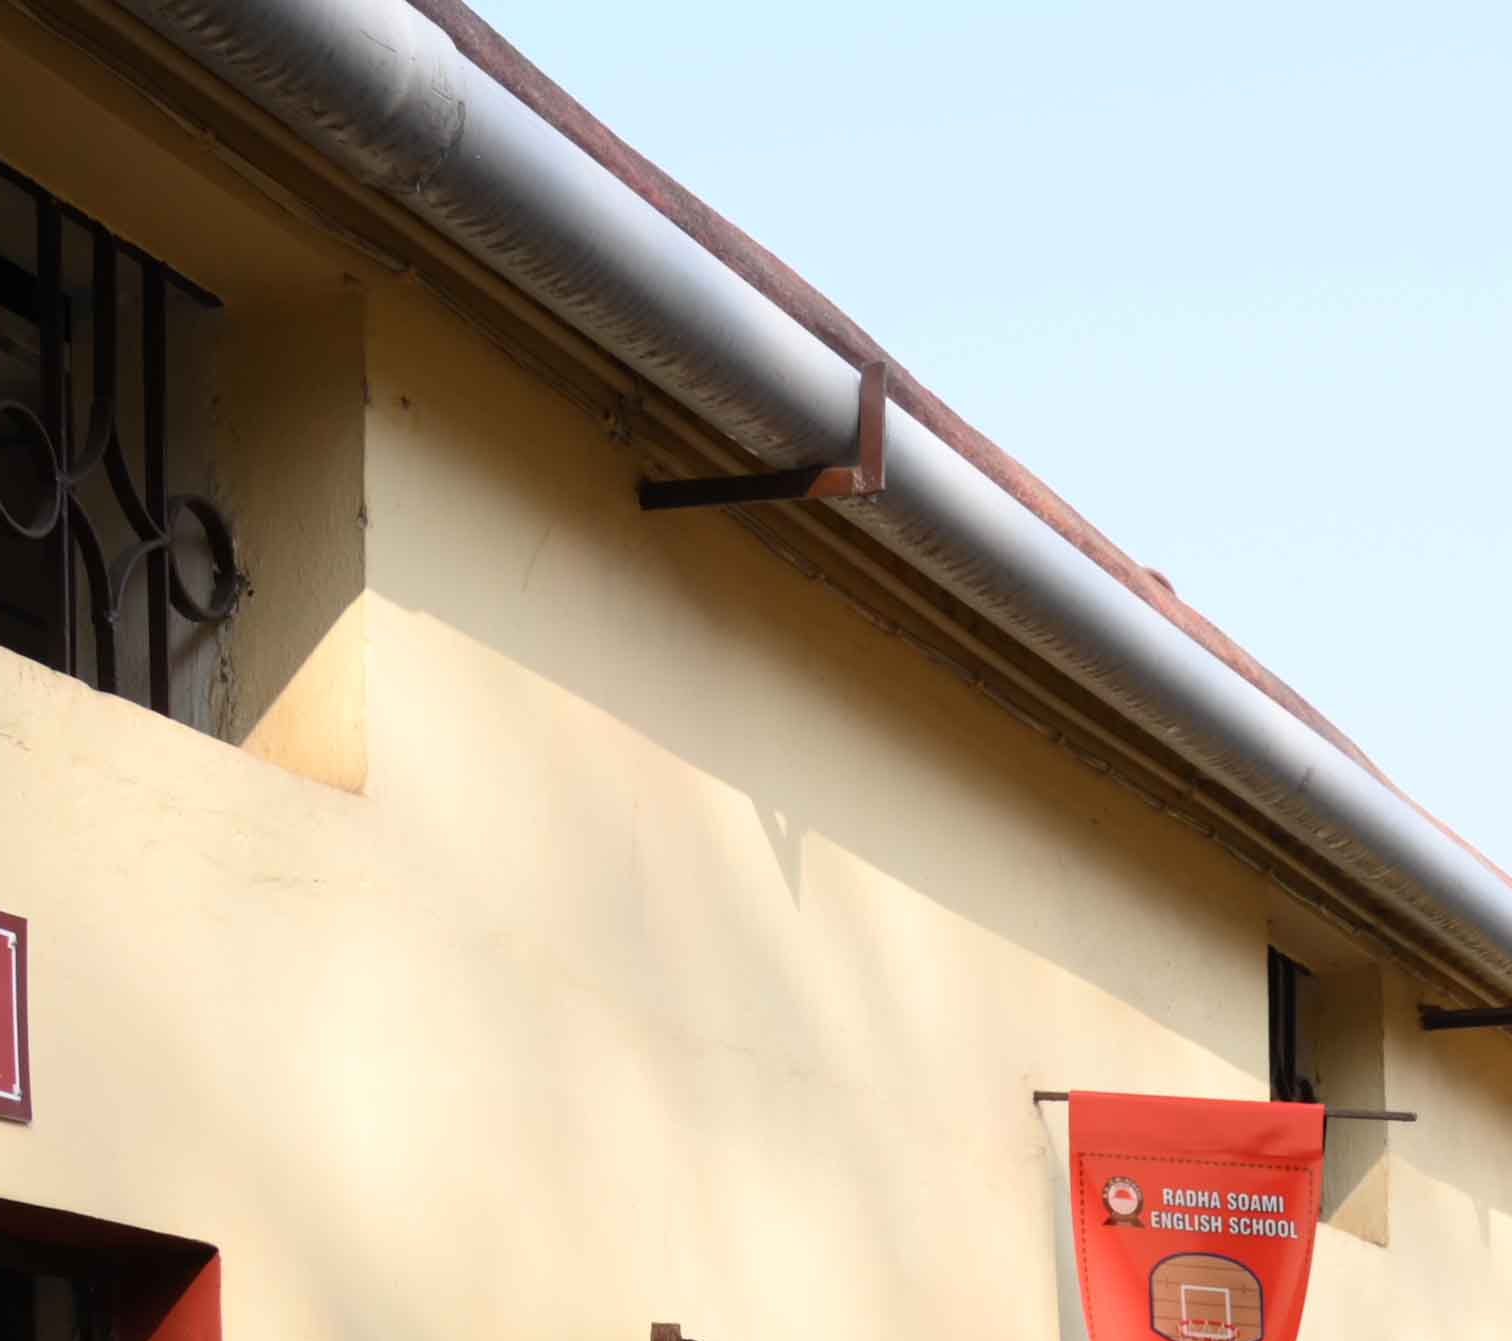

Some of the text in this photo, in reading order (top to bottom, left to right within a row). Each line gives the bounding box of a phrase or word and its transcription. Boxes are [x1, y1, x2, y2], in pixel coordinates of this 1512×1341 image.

[1163, 1188, 1221, 1209] RADHA
[1227, 1193, 1285, 1213] SOAMI
[1151, 1211, 1299, 1239] ENGLISH SCHOOL
